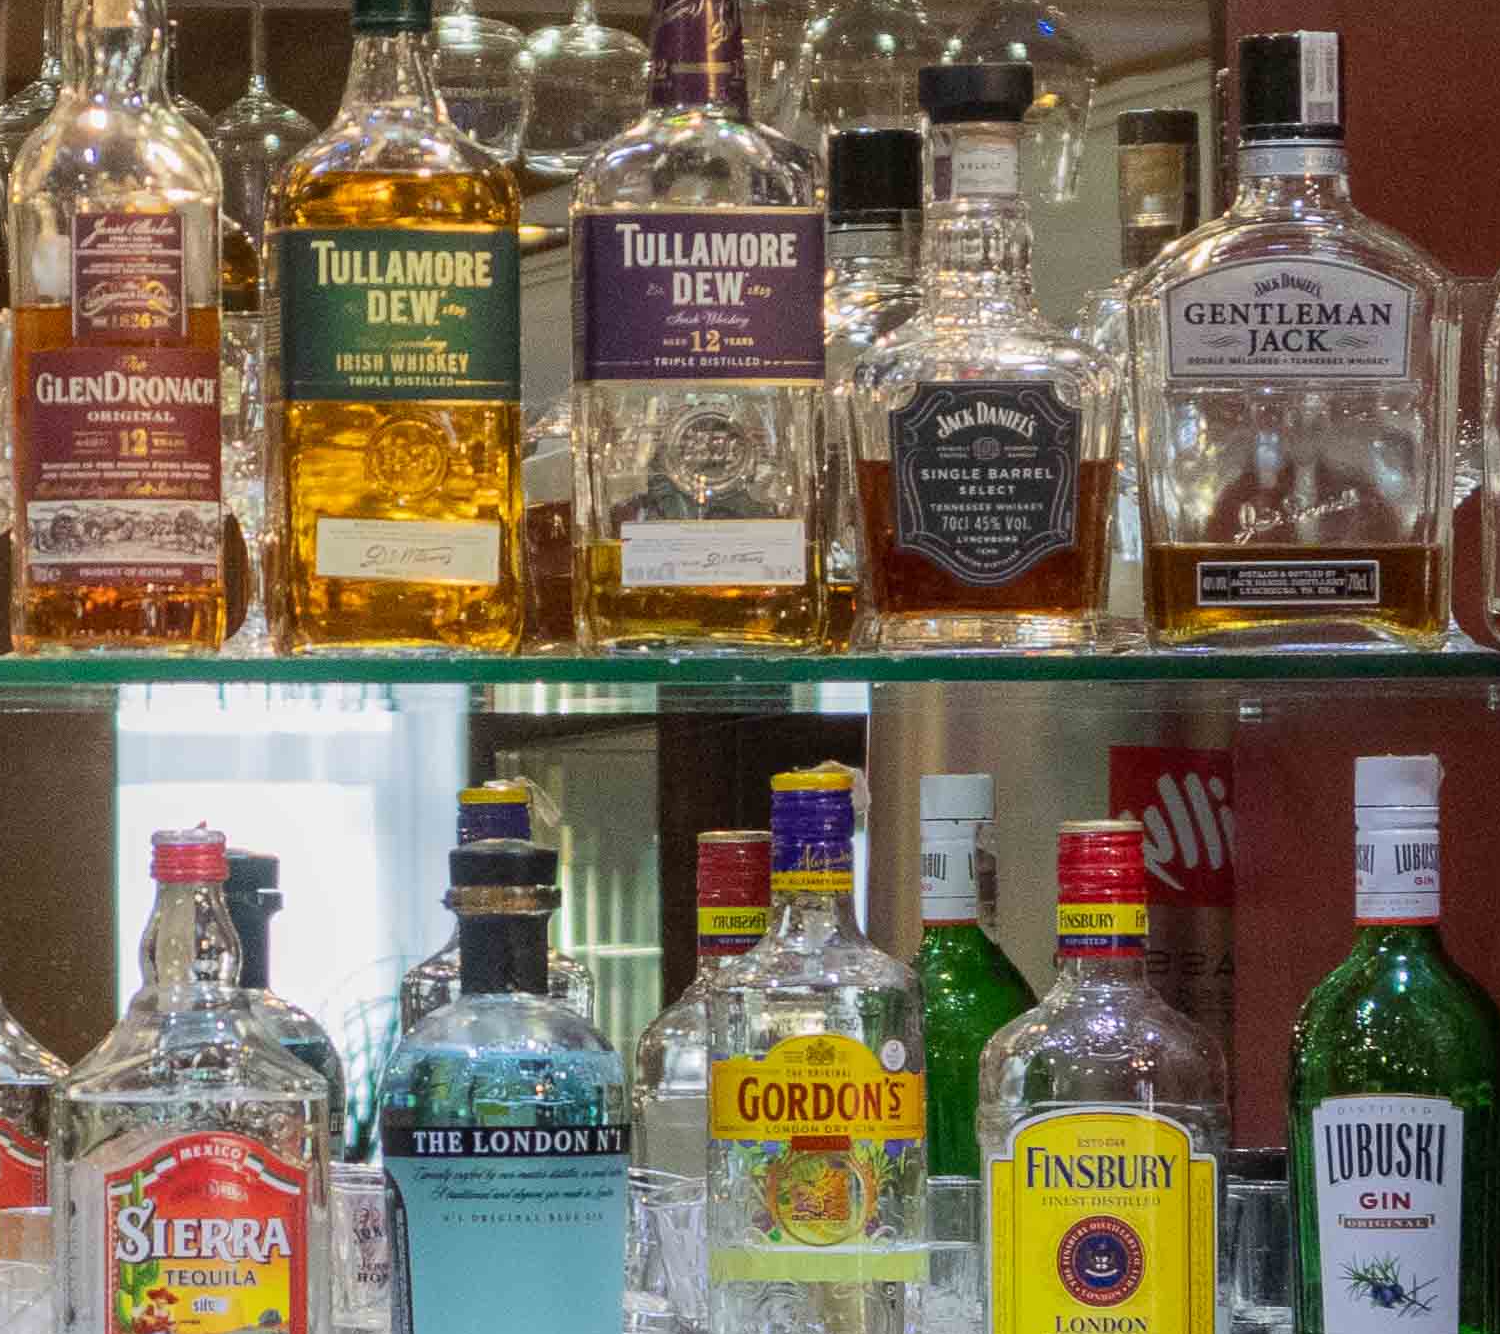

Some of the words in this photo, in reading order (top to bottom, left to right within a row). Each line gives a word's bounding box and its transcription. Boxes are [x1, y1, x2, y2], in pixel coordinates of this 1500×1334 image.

[615, 222, 798, 268] TULLAMORE
[310, 240, 494, 288] TULLAMORE
[1184, 302, 1392, 326] GENTLEMAN
[690, 330, 720, 354] 12
[1247, 328, 1328, 357] JACK
[335, 353, 385, 373] IRISH
[390, 352, 470, 374] WHISKEY
[653, 356, 696, 368] TRIPLE
[698, 356, 761, 368] DISTILLED
[348, 375, 391, 388] TRIPLE
[393, 376, 455, 388] DISTILLED
[86, 410, 176, 424] ORIGINAL
[935, 406, 974, 439] JACK
[119, 428, 150, 457] 12
[920, 467, 981, 482] SINGLE
[987, 466, 1055, 481] BARREL
[958, 485, 1017, 496] SELECT
[929, 502, 992, 513] TENNESSEE
[974, 516, 1001, 532] 45%
[1413, 875, 1436, 888] GIN
[737, 1076, 904, 1123] GORDON'S
[765, 1123, 819, 1134] LONDON
[824, 1123, 849, 1134] DRY
[412, 1130, 463, 1154] THE
[472, 1129, 589, 1154] LONDON
[178, 1142, 242, 1161] MEXICO
[1324, 1122, 1448, 1187] LUBUSKI
[1026, 1147, 1177, 1190] FINSBURY
[1041, 1194, 1086, 1207] FINEST
[1089, 1194, 1161, 1207] DISTILLED
[1358, 1191, 1412, 1210] GIN
[114, 1198, 291, 1264] SIERRA
[1345, 1218, 1425, 1229] ORIGINAL
[165, 1268, 257, 1286] TEQUILA
[1055, 1315, 1149, 1334] LONDON
